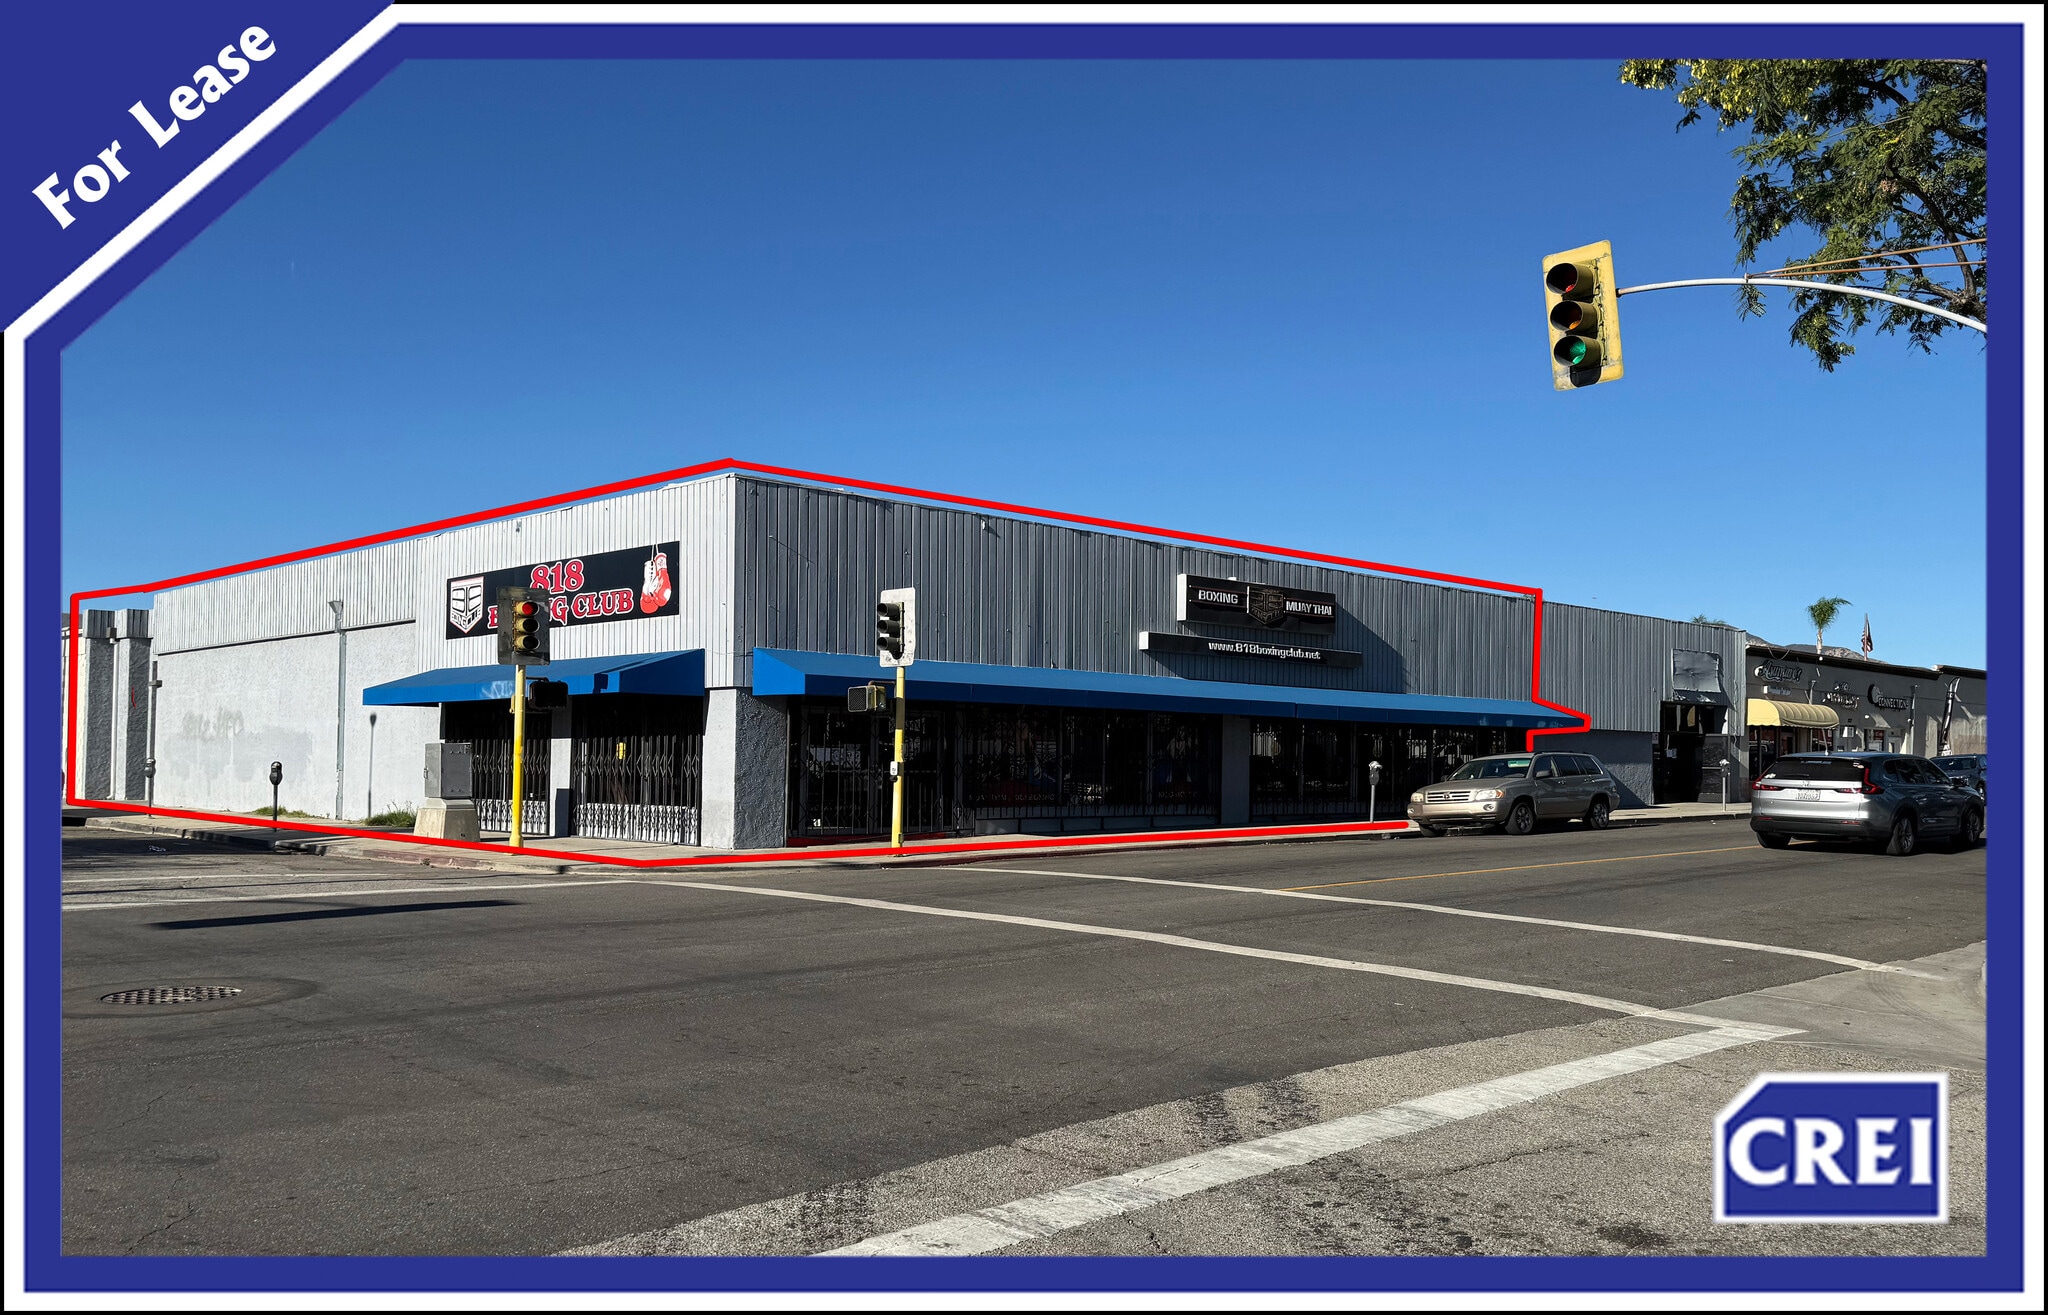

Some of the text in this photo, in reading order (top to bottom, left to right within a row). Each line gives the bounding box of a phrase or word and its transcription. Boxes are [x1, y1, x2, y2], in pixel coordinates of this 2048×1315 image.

[530, 559, 584, 594] 818
[571, 588, 634, 619] CLUB
[1198, 589, 1239, 604] BOXING
[1286, 601, 1333, 616] MUAY THAI
[1208, 642, 1321, 660] www.818boxingclub.net
